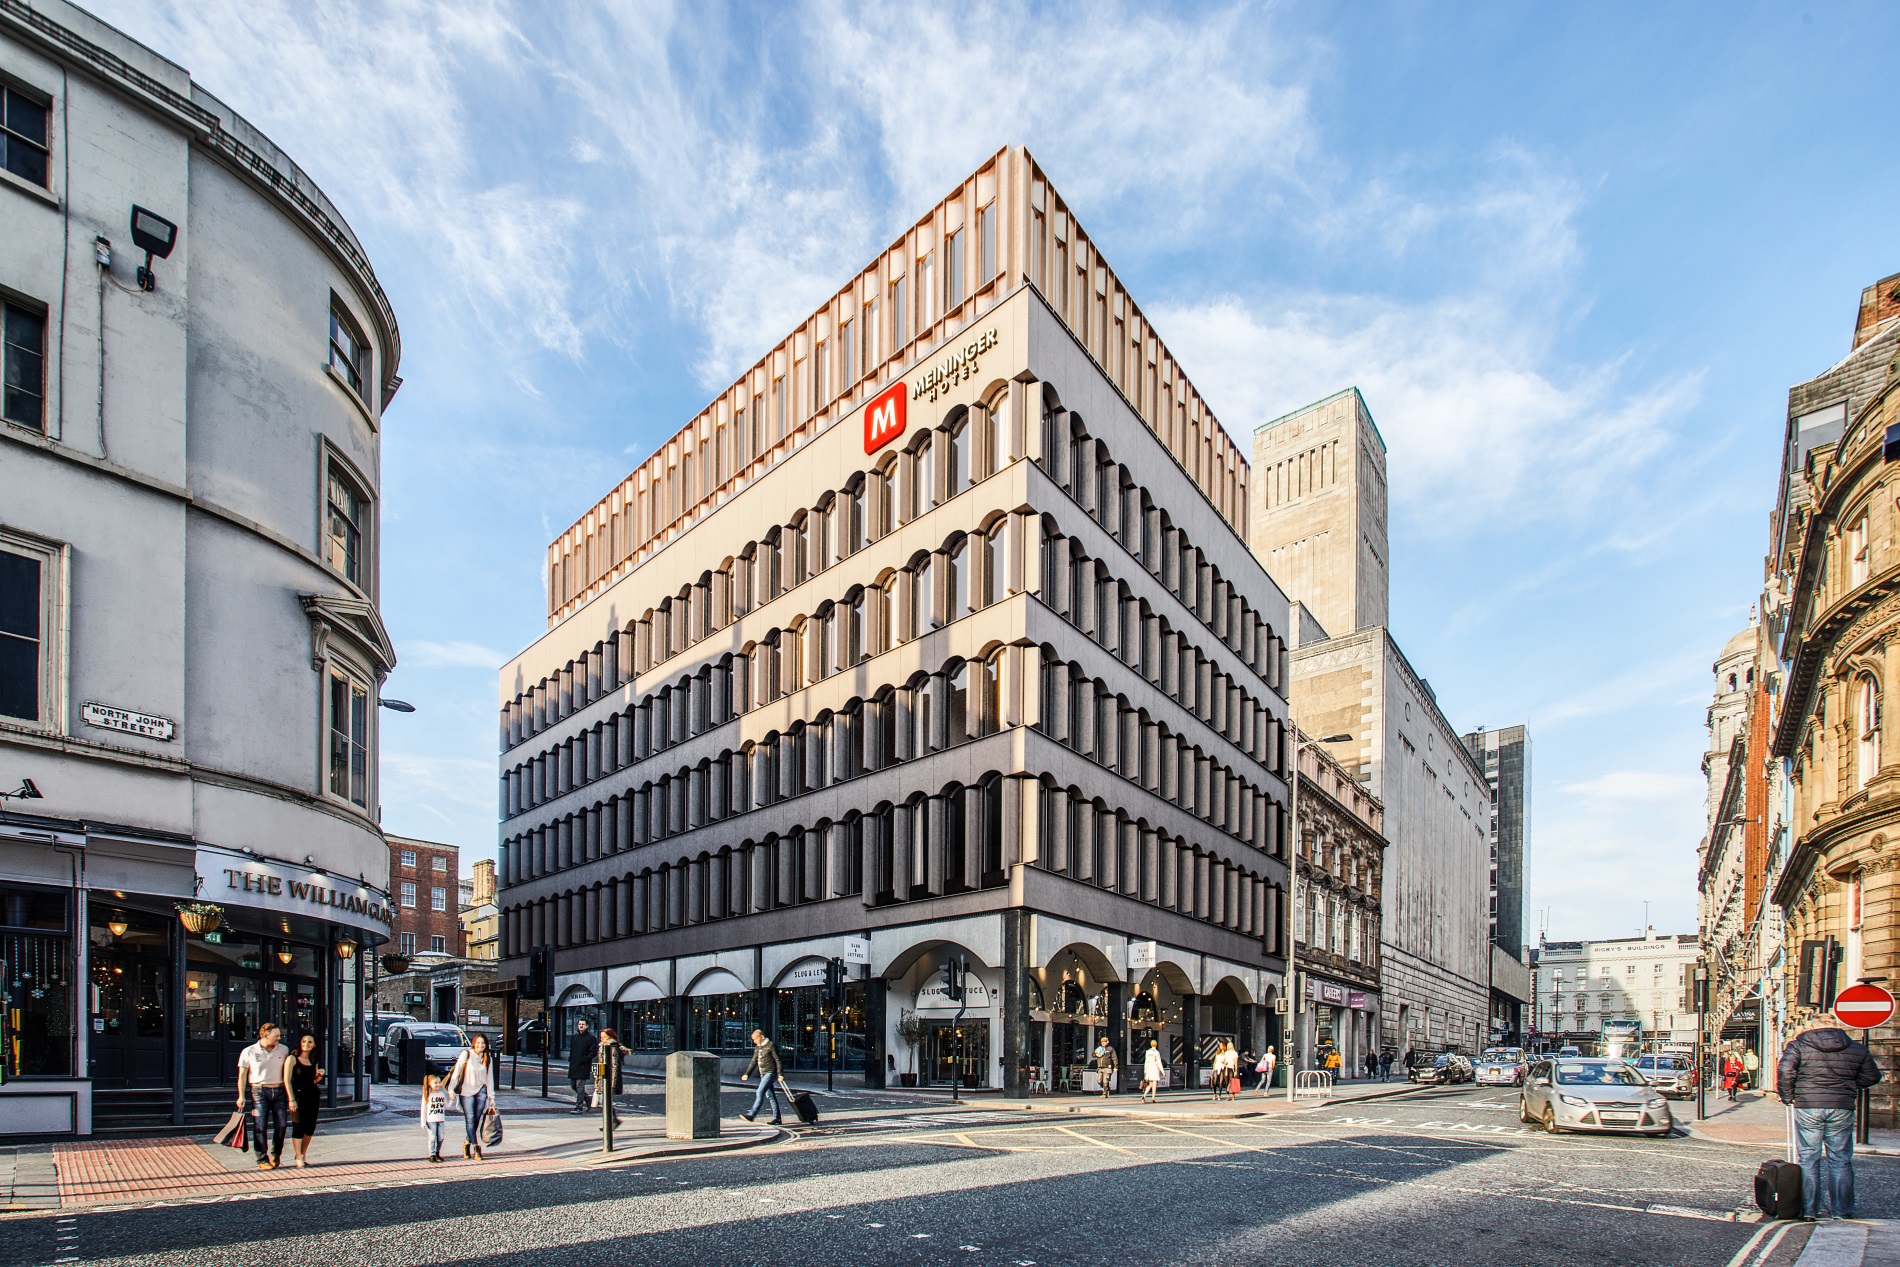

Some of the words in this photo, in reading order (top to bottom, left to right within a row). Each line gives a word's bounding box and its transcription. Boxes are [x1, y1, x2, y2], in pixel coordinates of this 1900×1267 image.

[913, 327, 998, 400] MEININGER
[930, 361, 979, 403] HOTEL
[871, 396, 897, 441] M
[92, 706, 129, 720] NORTH
[136, 716, 165, 728] JOHN
[103, 718, 154, 734] STREET
[223, 868, 283, 896] THE
[289, 879, 369, 915] WILLIAM
[794, 969, 808, 978] SLUG
[921, 988, 941, 996] SLUG
[1328, 1117, 1396, 1125] NO
